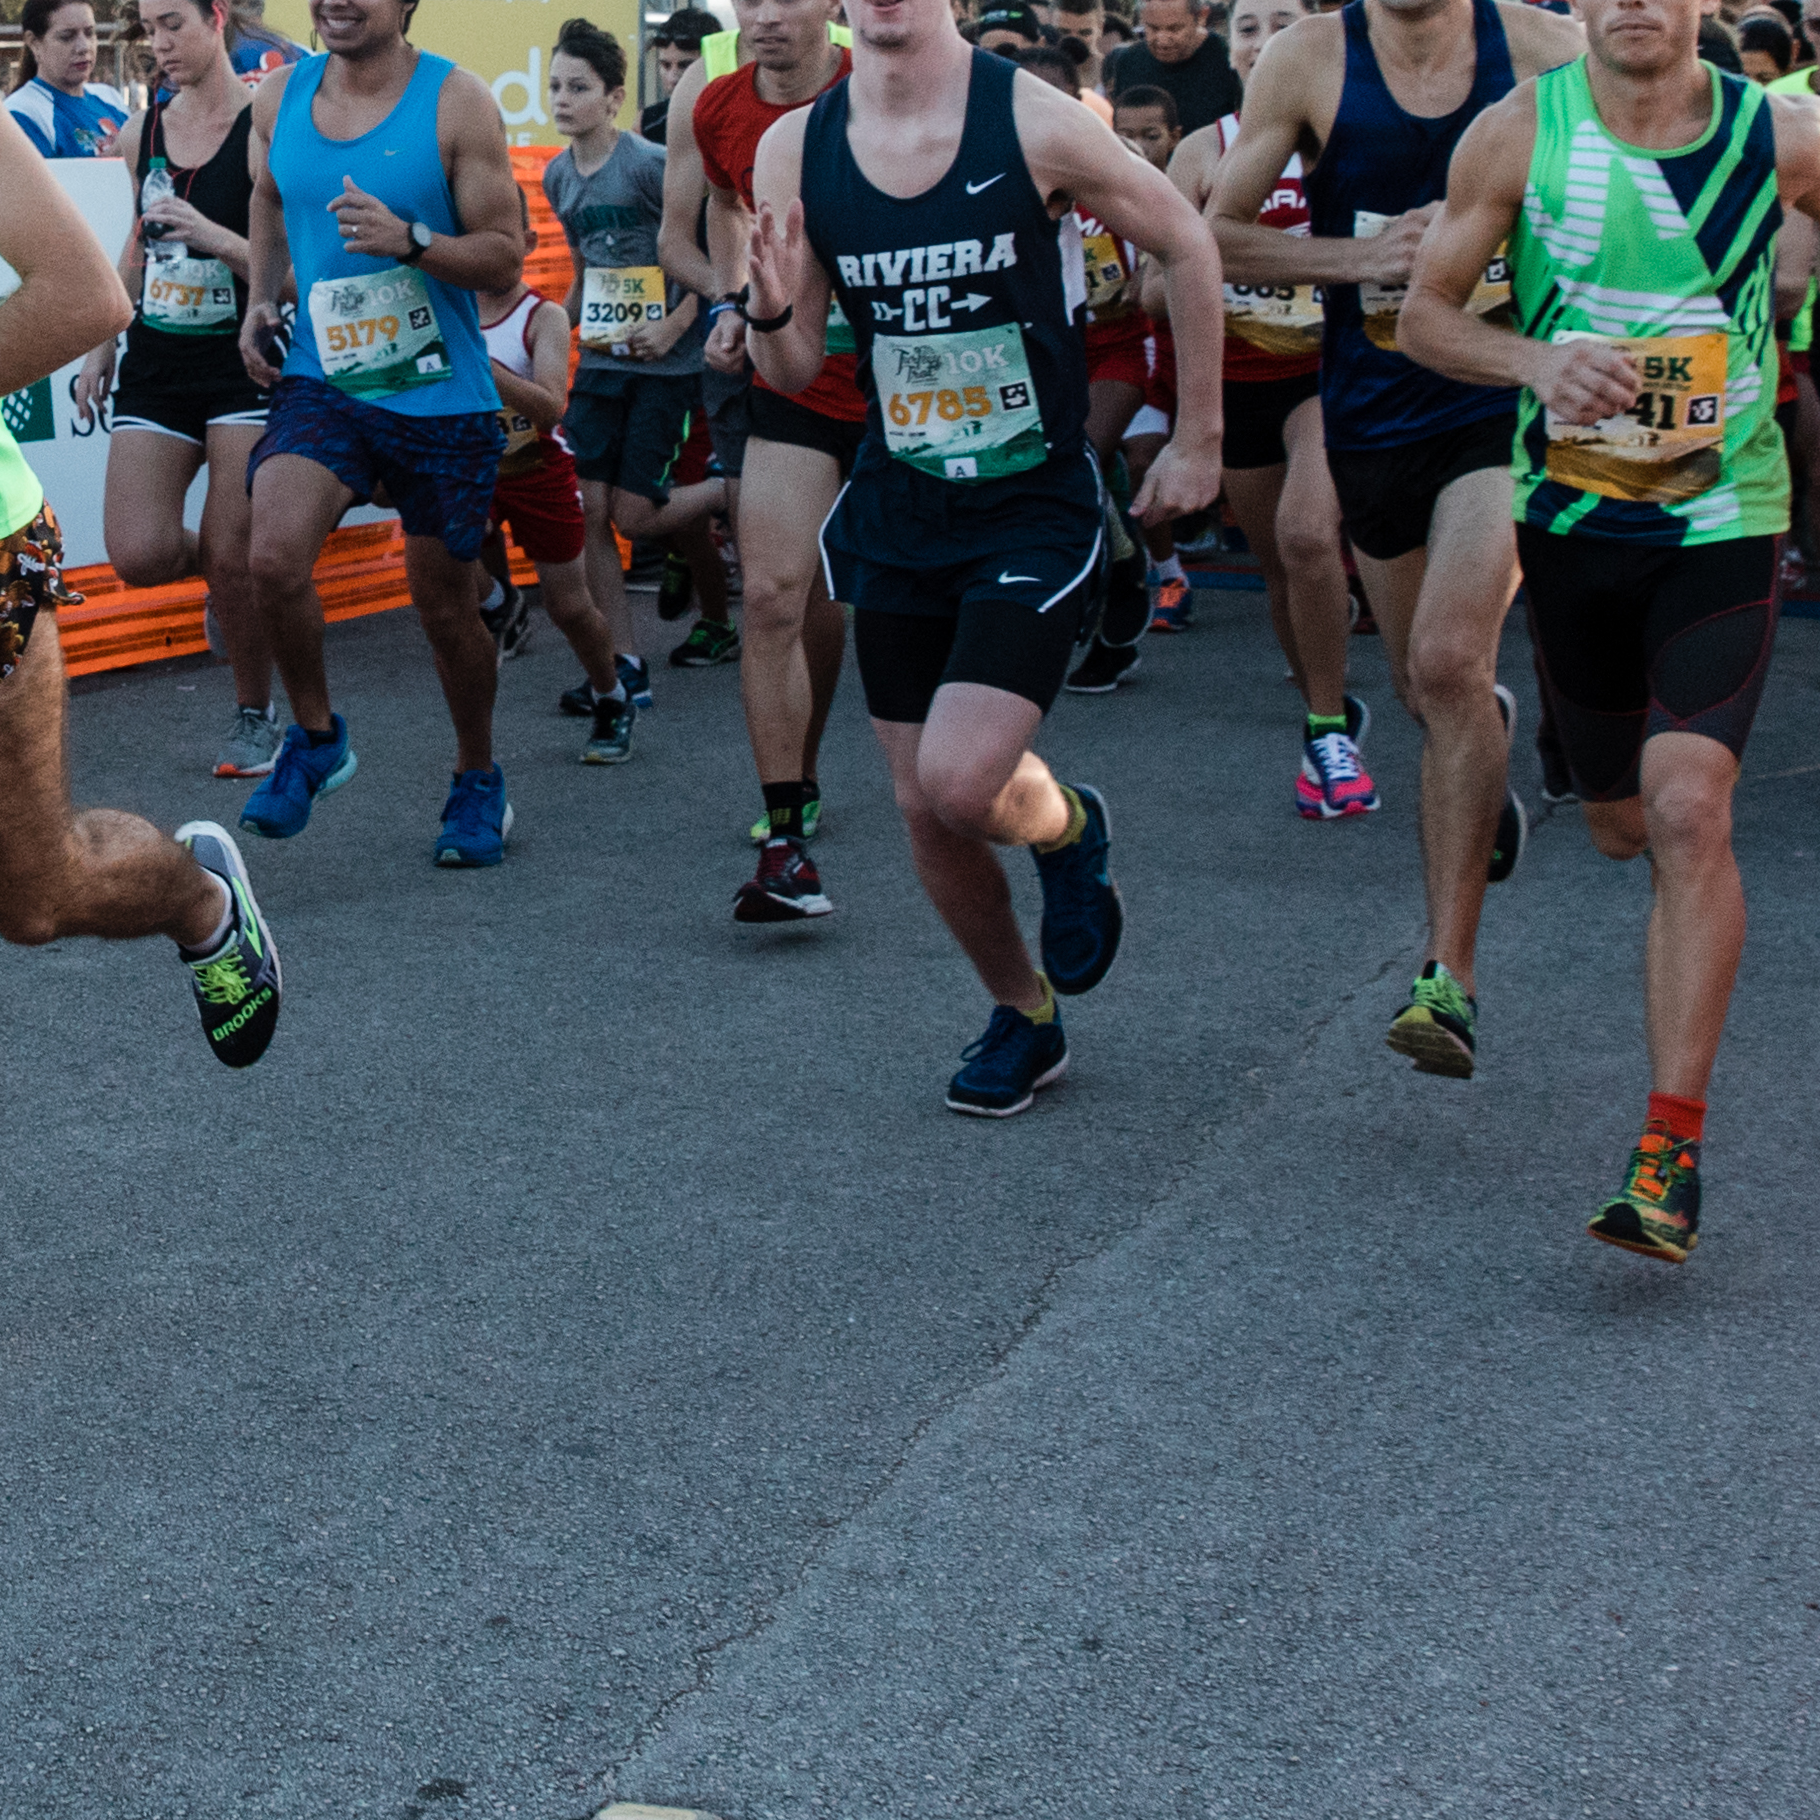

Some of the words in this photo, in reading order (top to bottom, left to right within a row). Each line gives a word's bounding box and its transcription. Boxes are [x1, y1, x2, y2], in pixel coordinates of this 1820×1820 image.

[837, 232, 1017, 288] RIVIERA
[150, 278, 206, 306] 6737
[365, 278, 415, 306] 10K
[623, 277, 646, 295] 5K
[586, 302, 642, 323] 3209
[903, 285, 952, 331] CC
[327, 315, 401, 351] 5179
[426, 361, 434, 371] A
[943, 343, 1009, 375] 10K
[1644, 356, 1693, 382] 5K
[888, 385, 993, 427] 6785
[955, 466, 966, 477] A
[212, 987, 272, 1041] BROOKS
